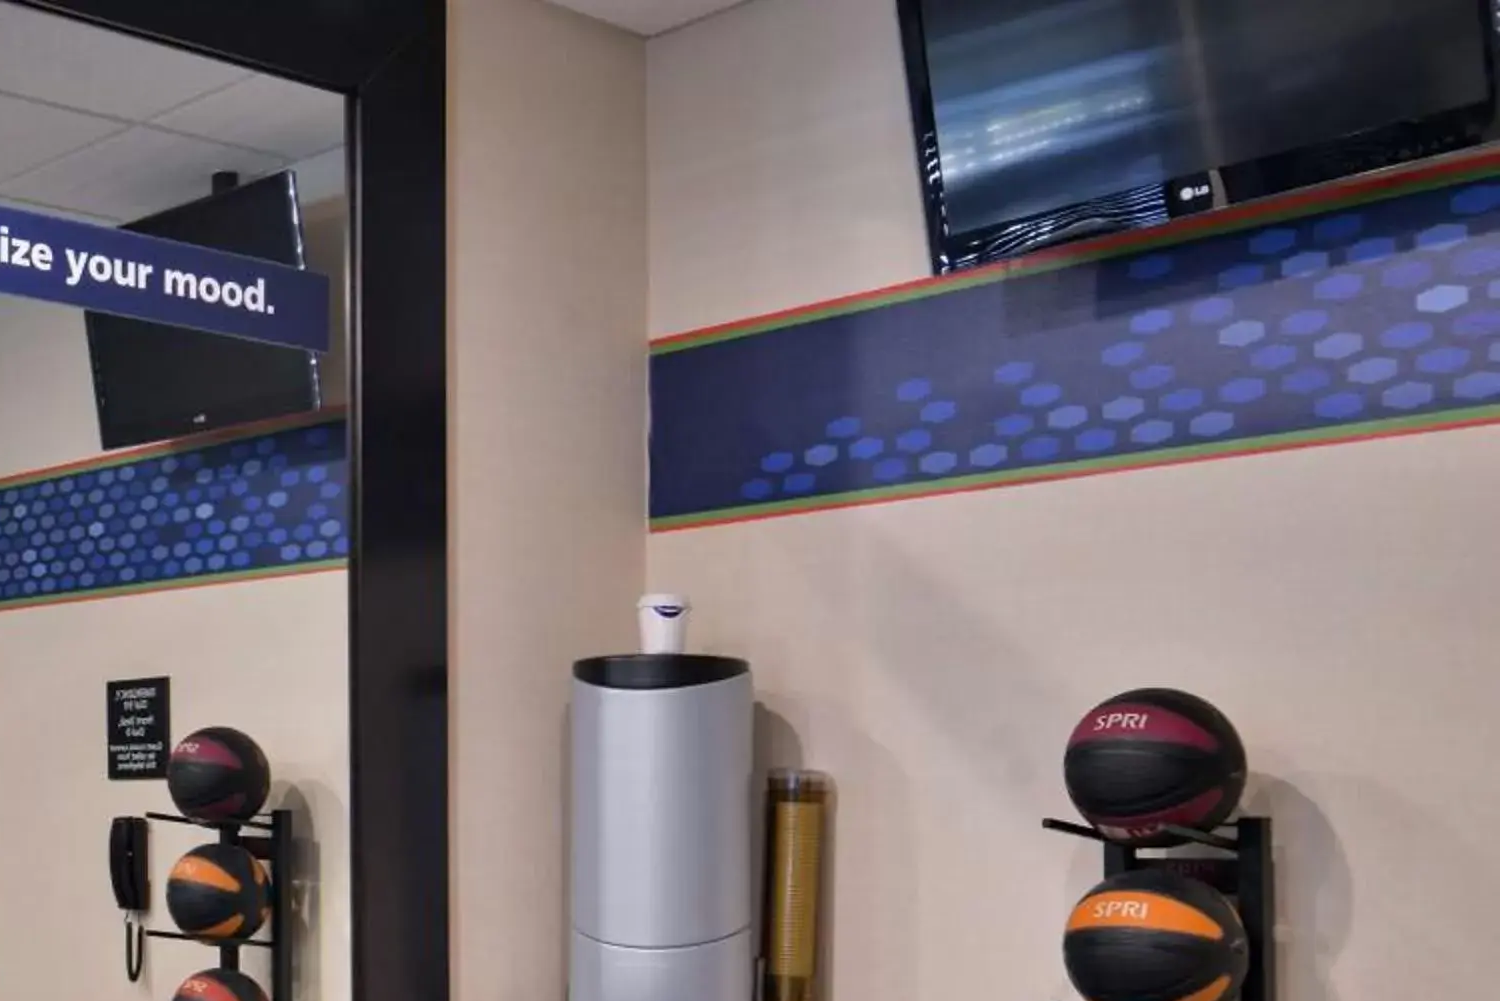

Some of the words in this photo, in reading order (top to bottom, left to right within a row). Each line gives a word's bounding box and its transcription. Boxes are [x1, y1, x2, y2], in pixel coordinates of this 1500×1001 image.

[64, 248, 153, 289] your
[164, 269, 275, 314] mood.
[1094, 713, 1149, 731] SPRI
[1093, 901, 1149, 919] SPRI
